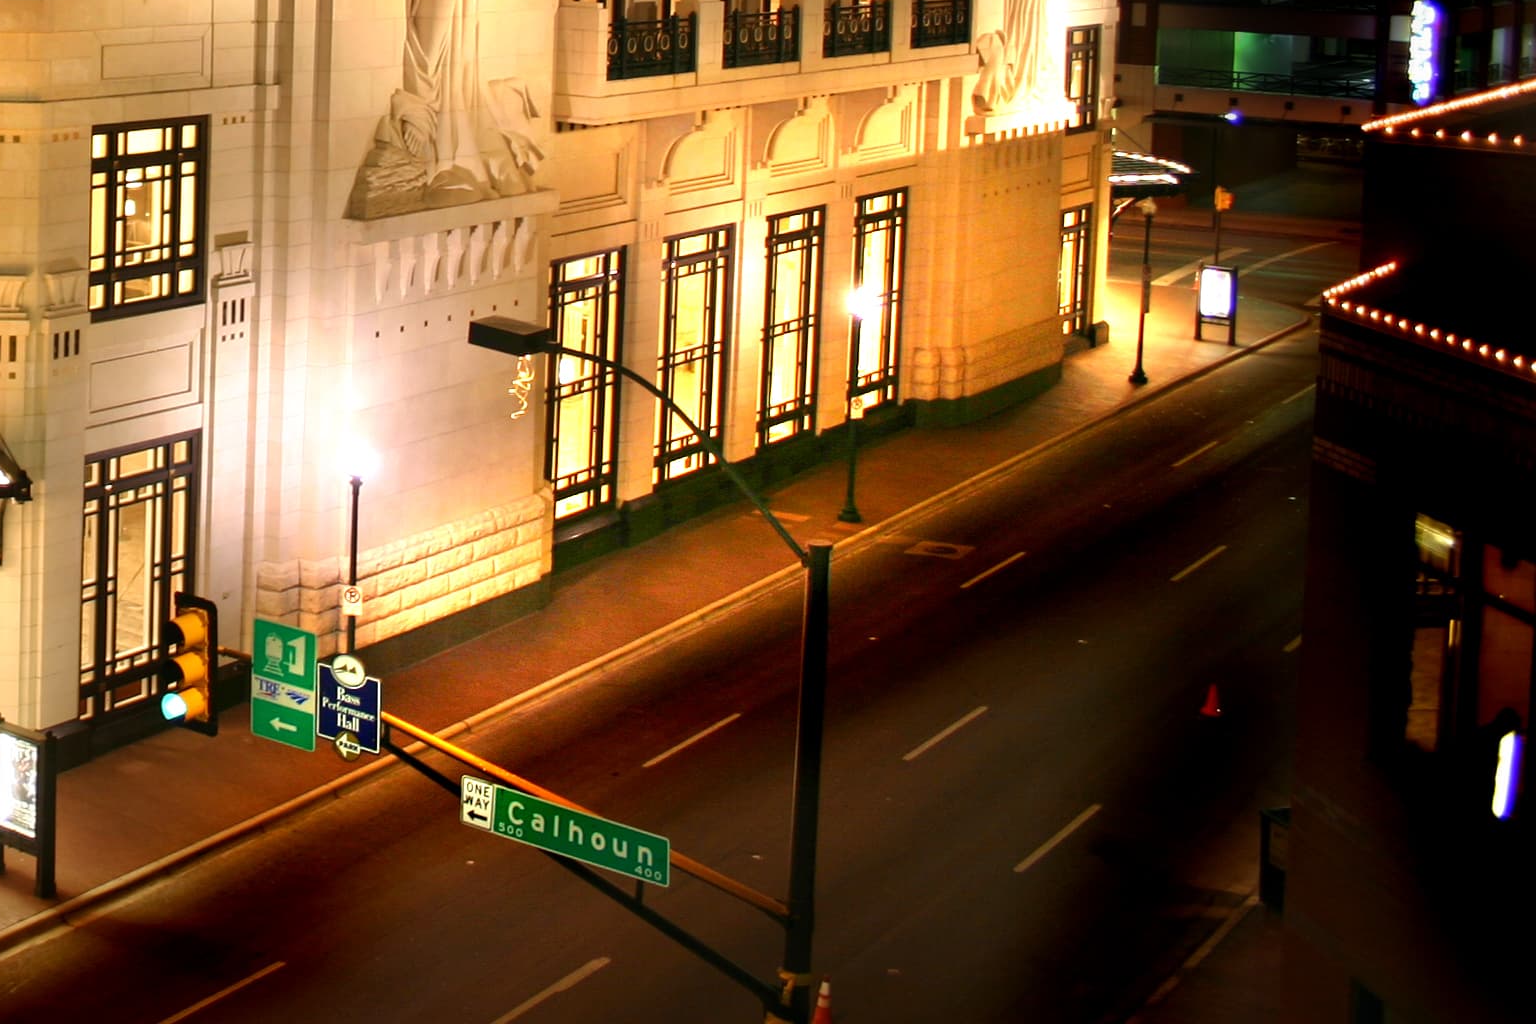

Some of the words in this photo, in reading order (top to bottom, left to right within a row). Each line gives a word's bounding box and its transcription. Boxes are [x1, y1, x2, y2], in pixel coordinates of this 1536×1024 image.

[337, 686, 361, 706] Bass
[322, 696, 376, 722] Performance
[337, 713, 360, 733] Hall
[339, 740, 359, 752] PARK
[467, 781, 491, 798] ONE
[464, 794, 490, 811] WAY
[498, 822, 523, 838] 500
[508, 801, 653, 867] Calhoun
[634, 865, 662, 881] 400
